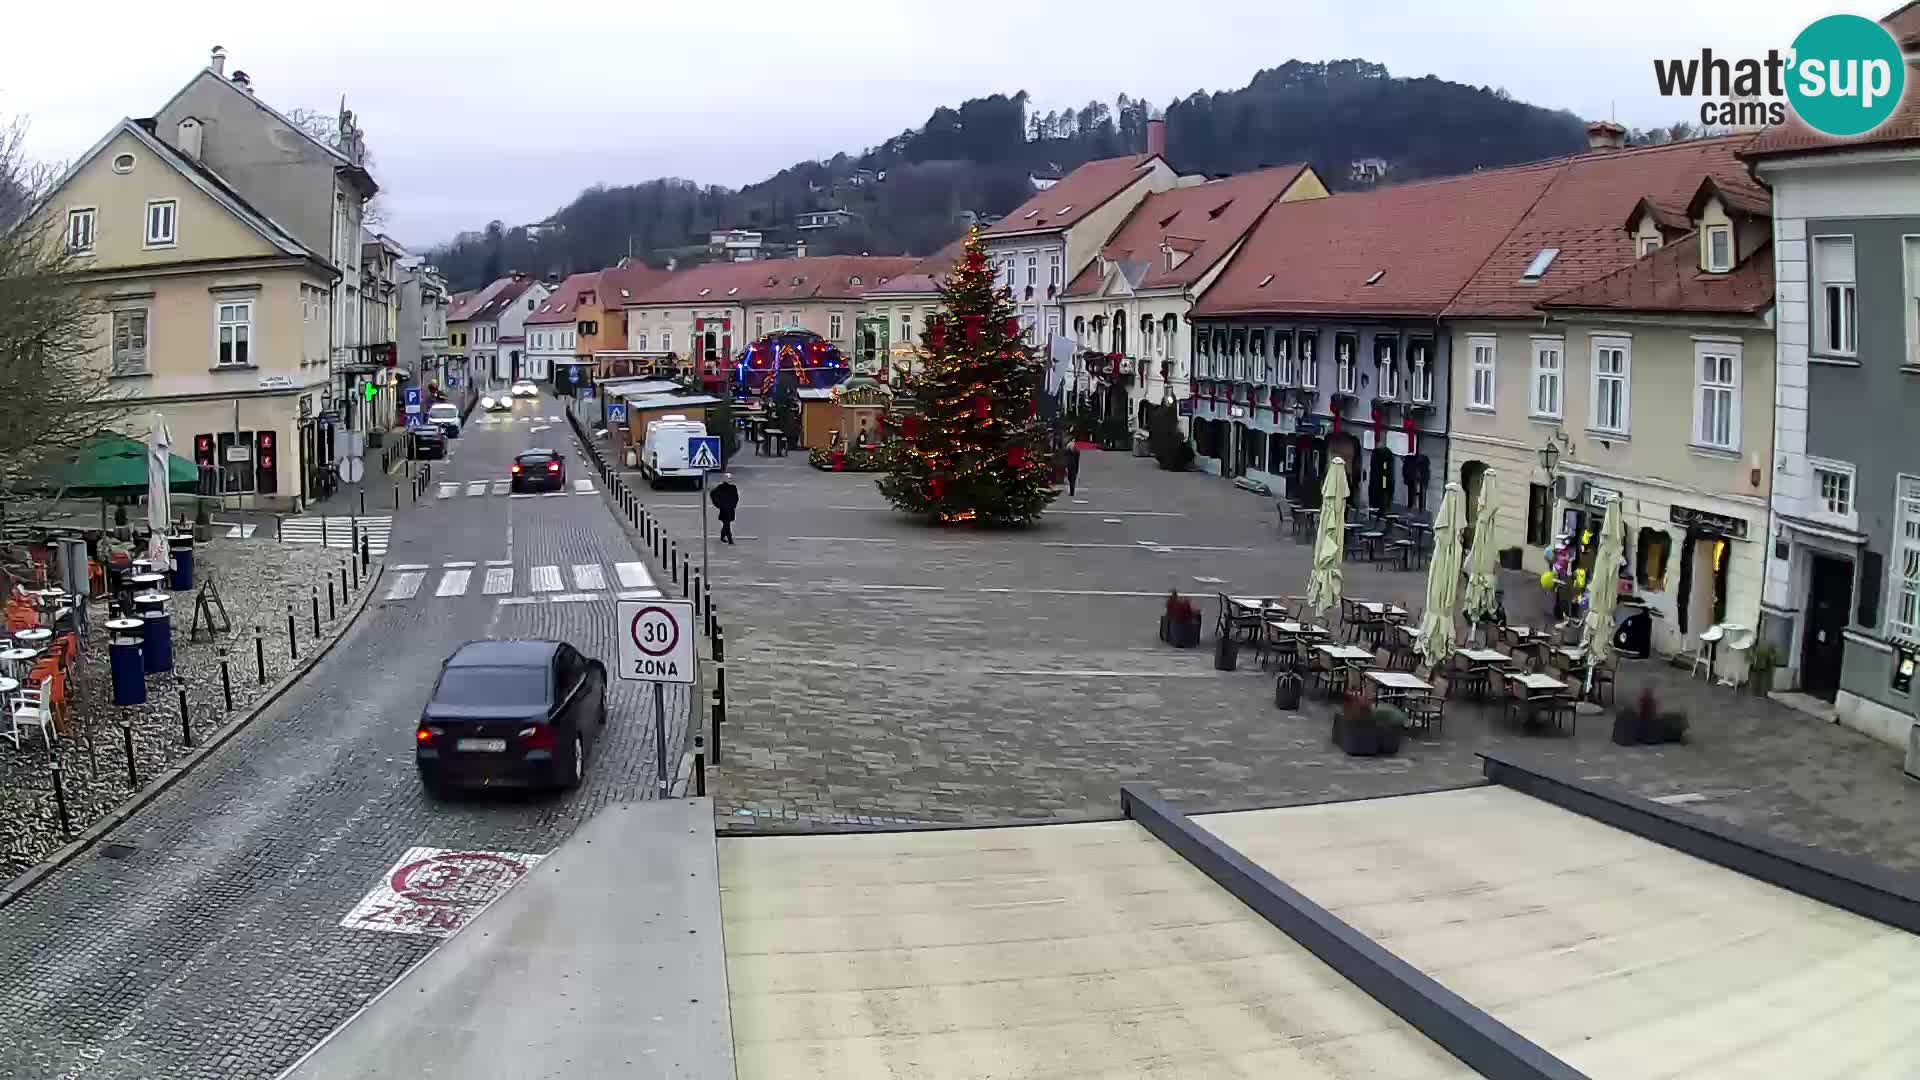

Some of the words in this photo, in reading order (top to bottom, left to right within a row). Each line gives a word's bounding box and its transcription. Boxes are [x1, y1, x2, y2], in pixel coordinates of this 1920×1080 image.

[408, 391, 417, 402] P
[643, 622, 668, 643] 30
[634, 659, 678, 676] ZONA
